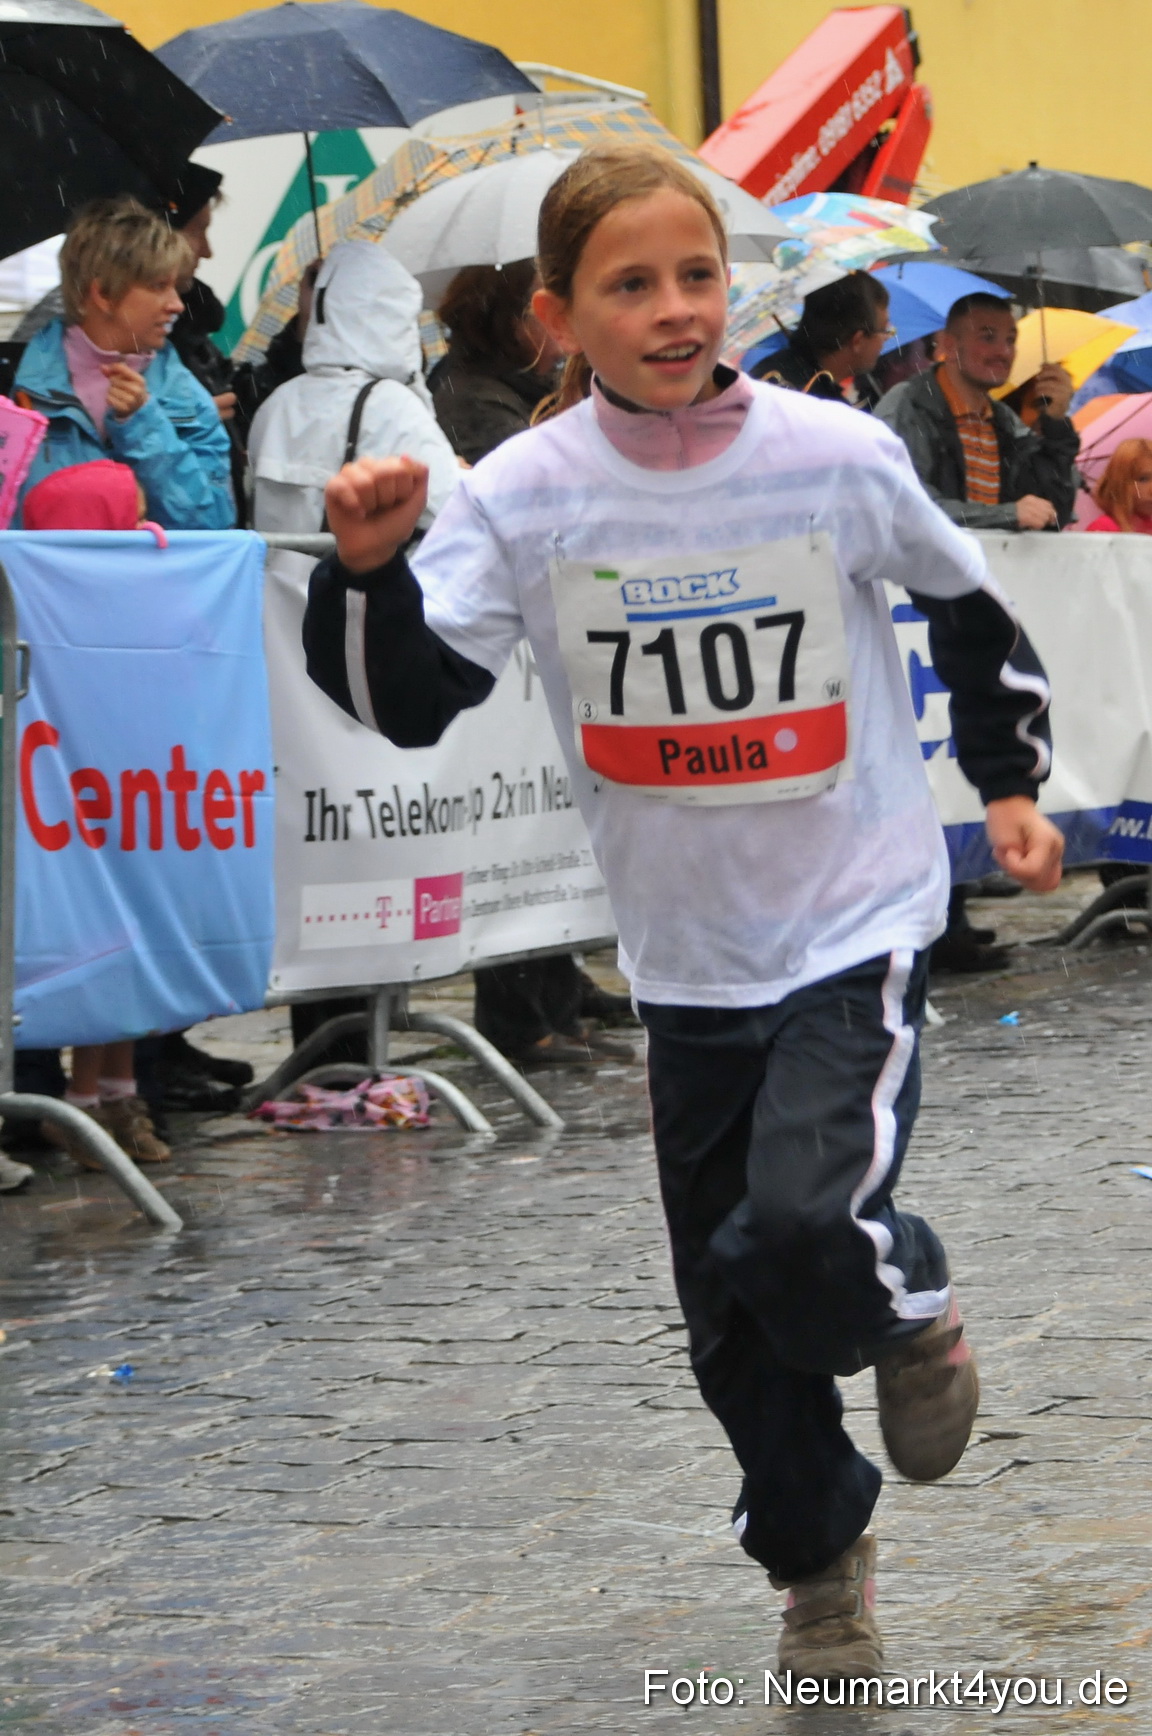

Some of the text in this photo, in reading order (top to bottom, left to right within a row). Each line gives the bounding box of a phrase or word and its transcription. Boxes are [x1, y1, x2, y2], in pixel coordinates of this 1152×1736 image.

[621, 567, 740, 606] BOCK
[586, 609, 806, 716] 7107
[583, 702, 593, 719] 3
[657, 734, 768, 775] Paula
[20, 719, 267, 852] Center
[303, 787, 352, 843] Ihr
[541, 764, 577, 813] Neu
